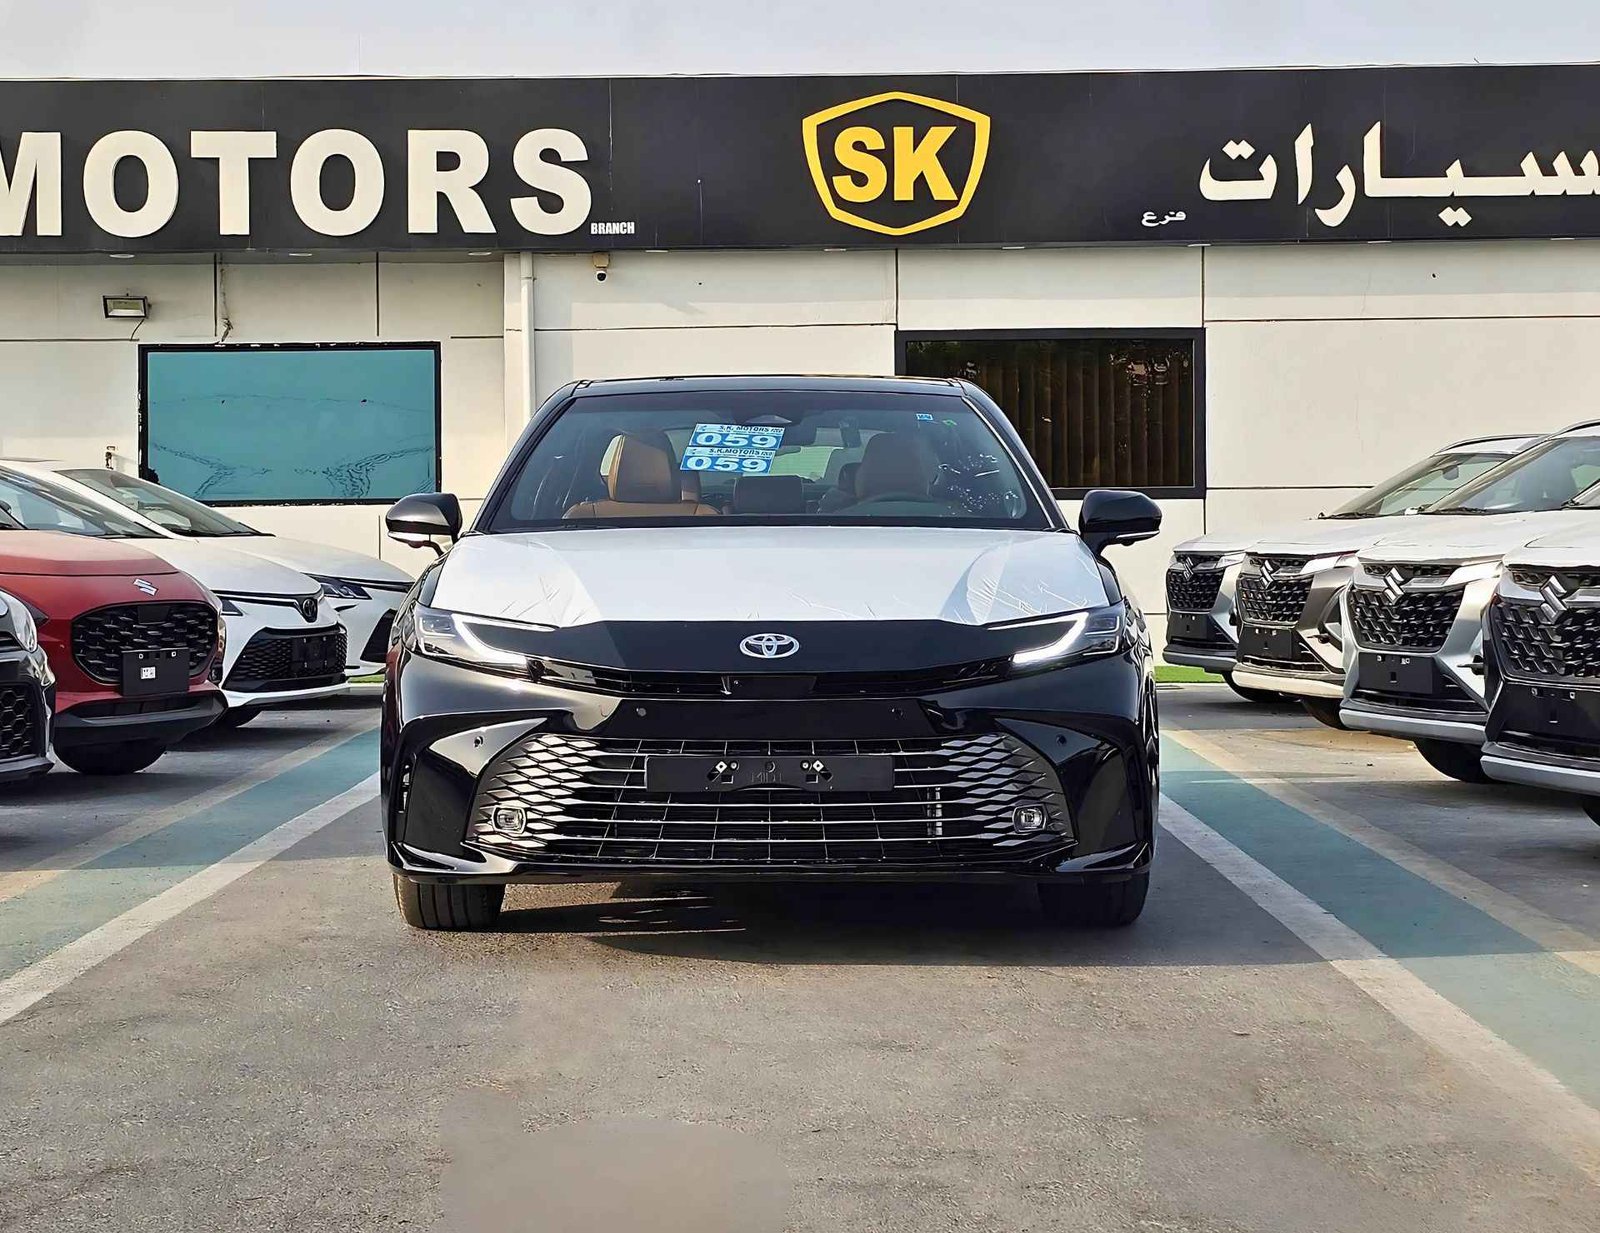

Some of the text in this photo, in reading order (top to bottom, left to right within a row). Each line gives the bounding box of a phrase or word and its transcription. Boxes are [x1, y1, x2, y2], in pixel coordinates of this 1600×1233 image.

[832, 125, 958, 202] SK
[0, 129, 592, 238] MOTORS
[1141, 211, 1187, 227] فرع
[590, 221, 636, 235] BRANCH
[696, 432, 778, 448] 059
[686, 456, 768, 472] 059
